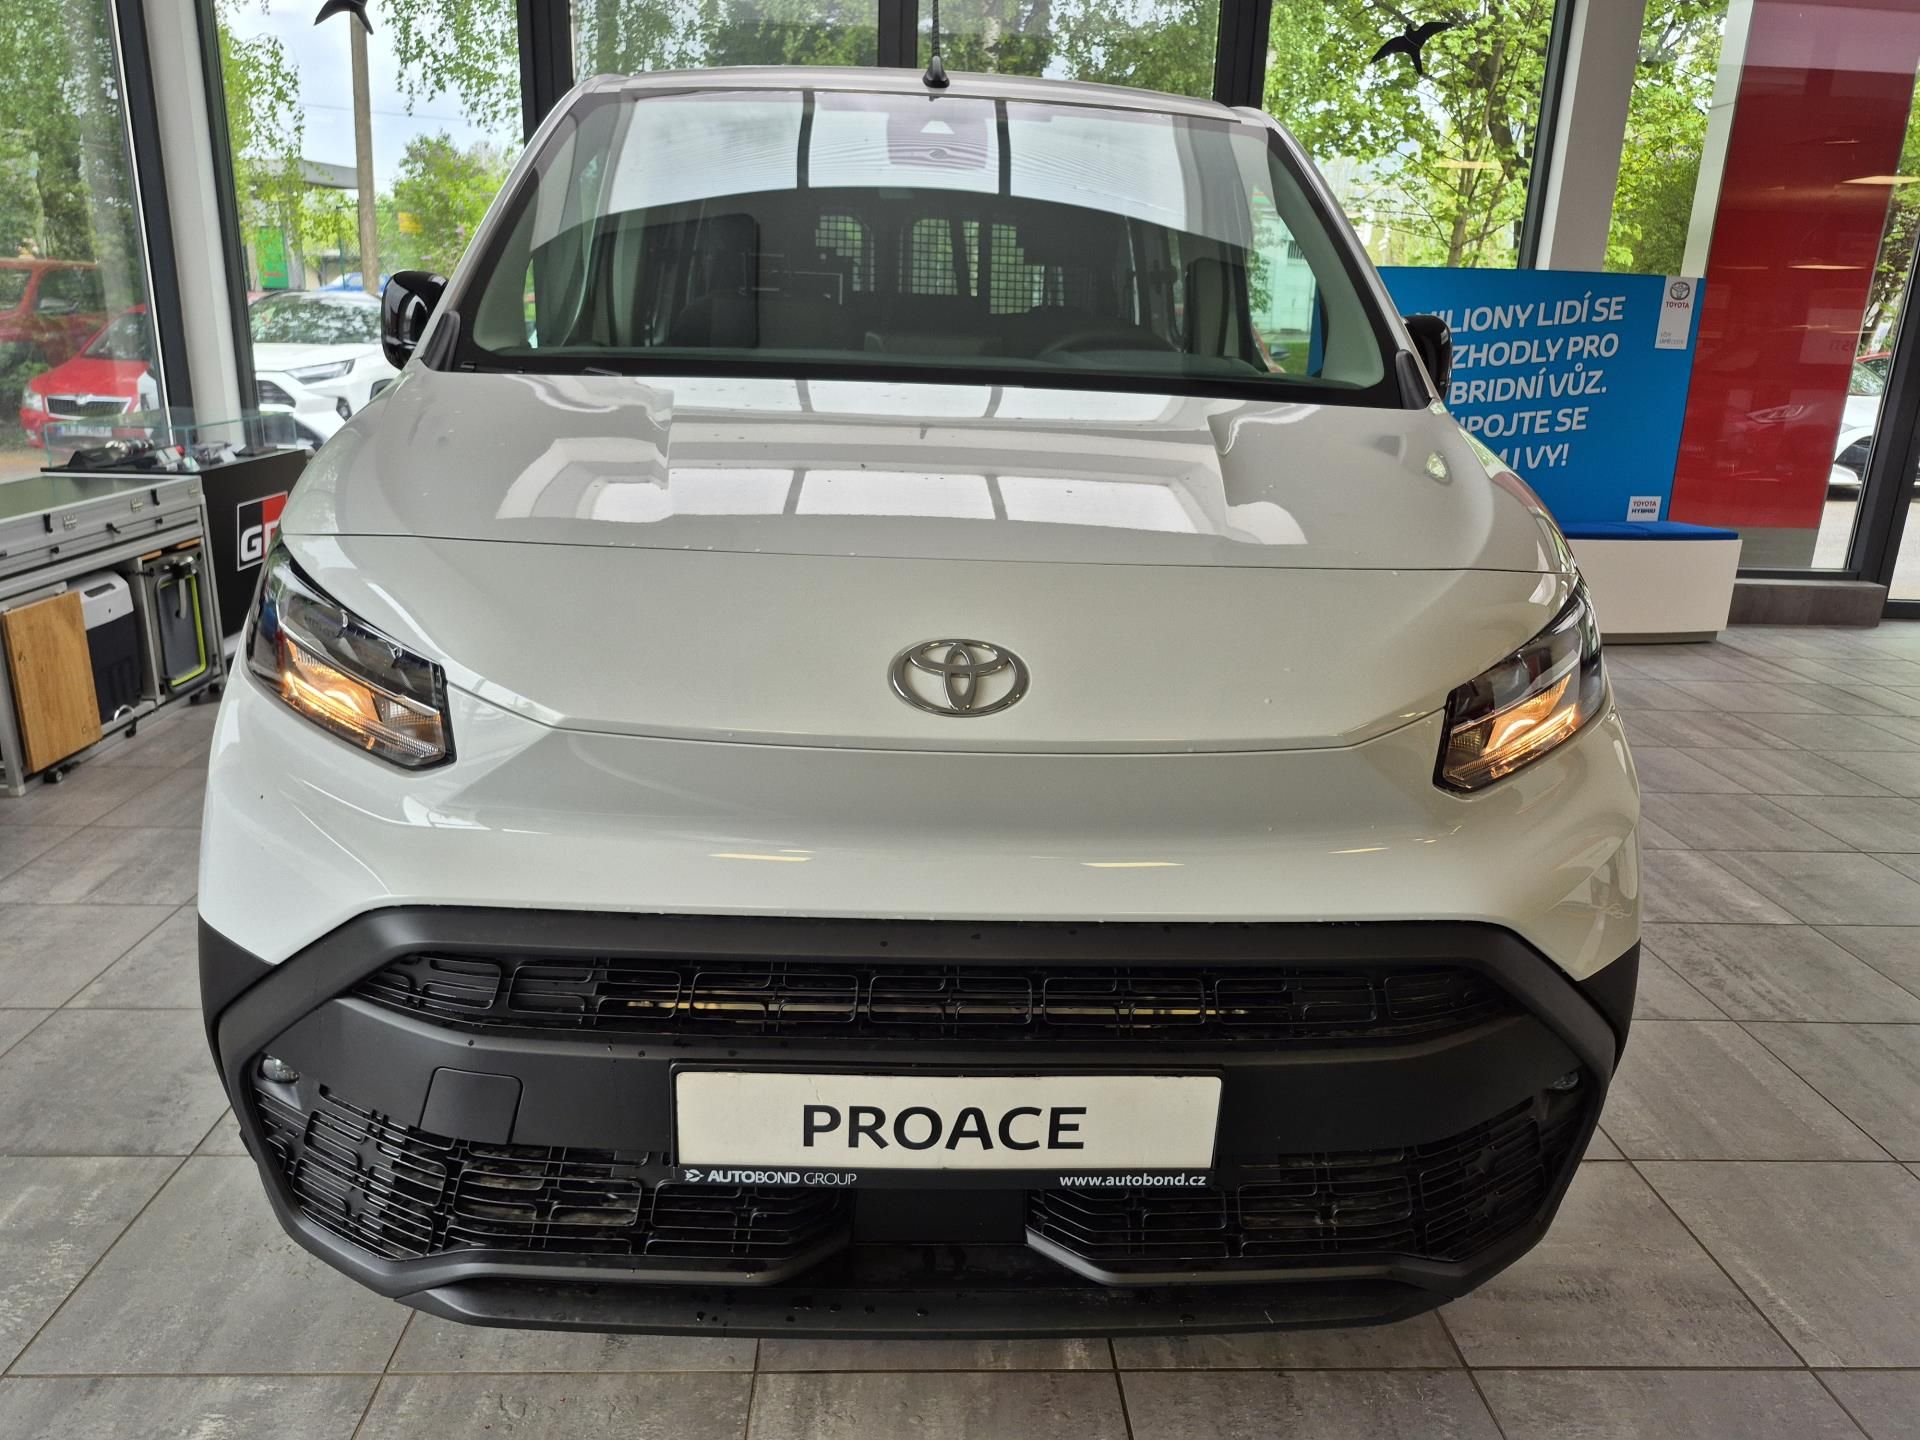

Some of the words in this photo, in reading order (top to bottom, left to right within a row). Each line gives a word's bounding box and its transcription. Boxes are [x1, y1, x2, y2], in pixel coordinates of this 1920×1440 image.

[1416, 303, 1534, 334] LIONY
[1537, 290, 1592, 326] LIDÍ
[1592, 296, 1626, 322] SE
[1665, 301, 1690, 309] TOYOTA
[1566, 333, 1619, 360] PRO
[1548, 362, 1607, 398] VŮZ.
[1554, 406, 1589, 433] SE
[1525, 443, 1569, 470] VY!
[802, 1103, 1087, 1151] PROACE
[707, 1169, 800, 1184] AUTOBOND
[803, 1172, 857, 1185] GROUP
[1059, 1172, 1207, 1186] www.autobond.cz
